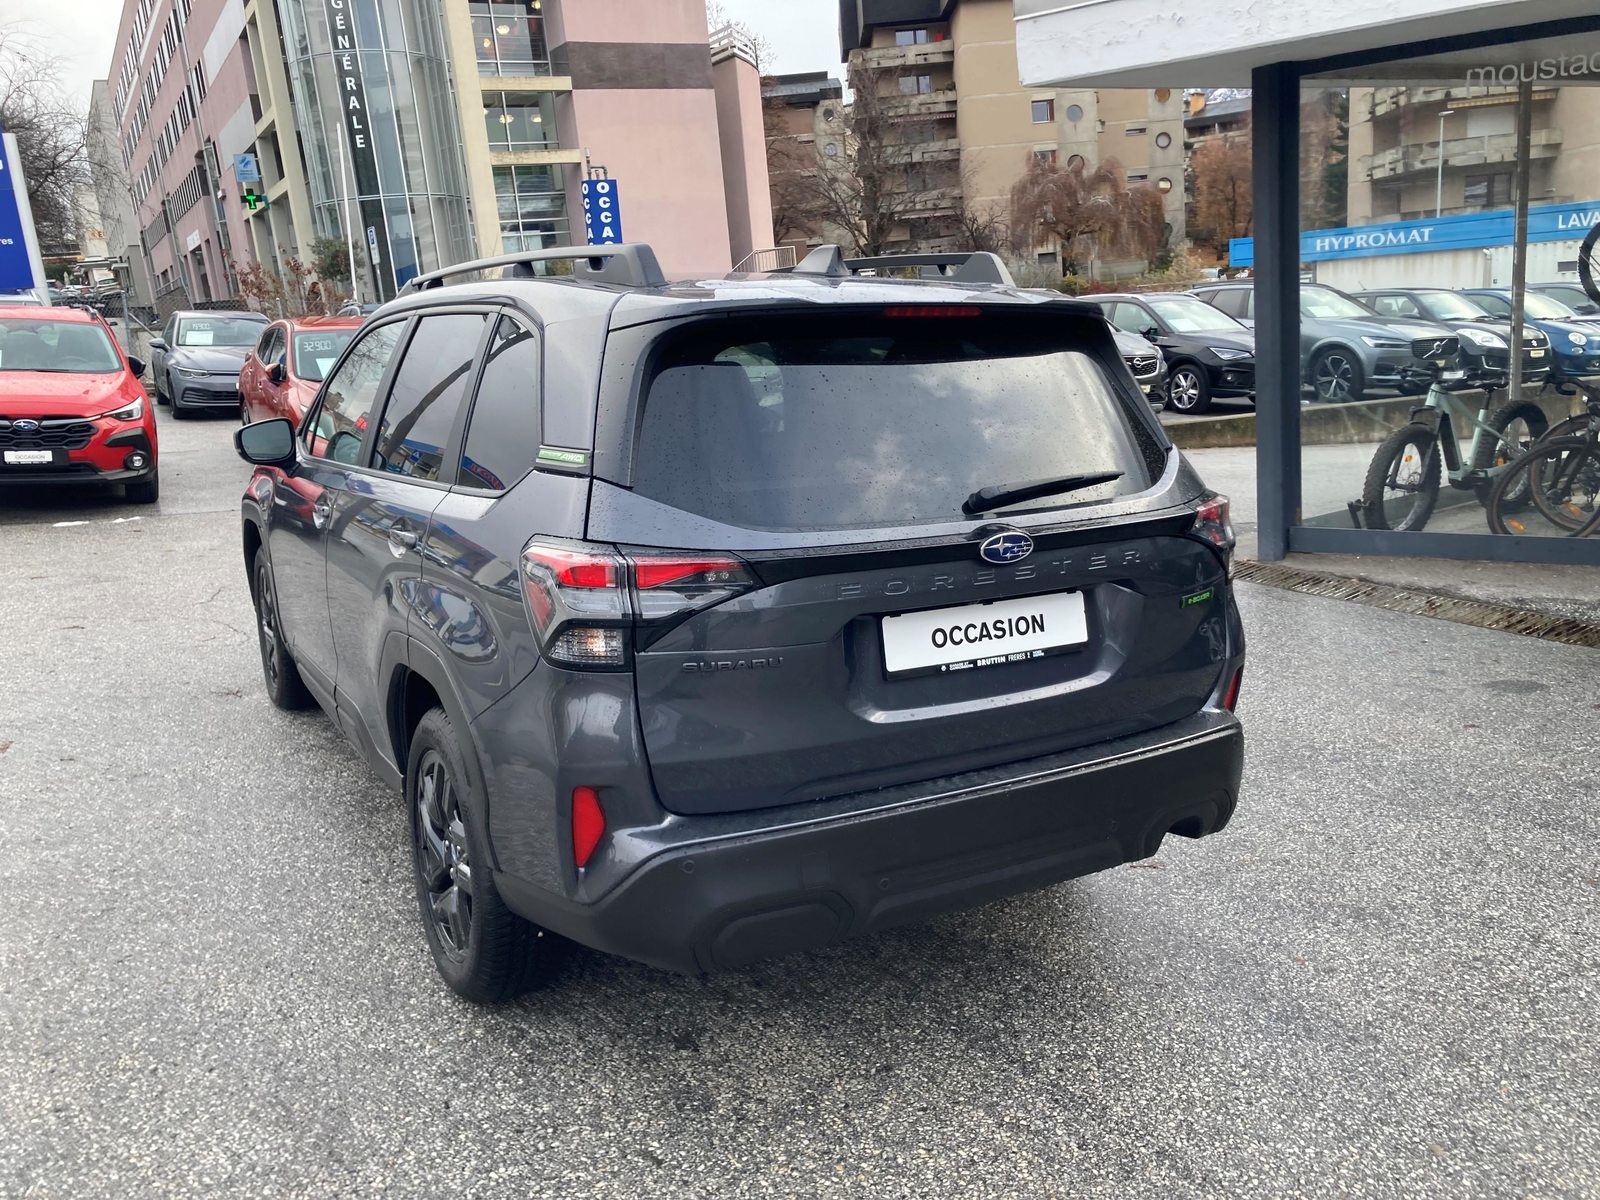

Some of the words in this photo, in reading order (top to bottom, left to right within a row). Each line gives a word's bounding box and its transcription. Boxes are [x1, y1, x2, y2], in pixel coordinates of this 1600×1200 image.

[582, 183, 595, 246] OCCA
[596, 182, 615, 245] OCCA
[1316, 227, 1434, 251] HYPROMAT
[1558, 211, 1600, 230] LAVA
[837, 550, 1141, 600] FORESTER
[931, 613, 1045, 648] OCCASION
[682, 656, 784, 673] SUBARU
[976, 655, 1006, 667] BRUTTIN
